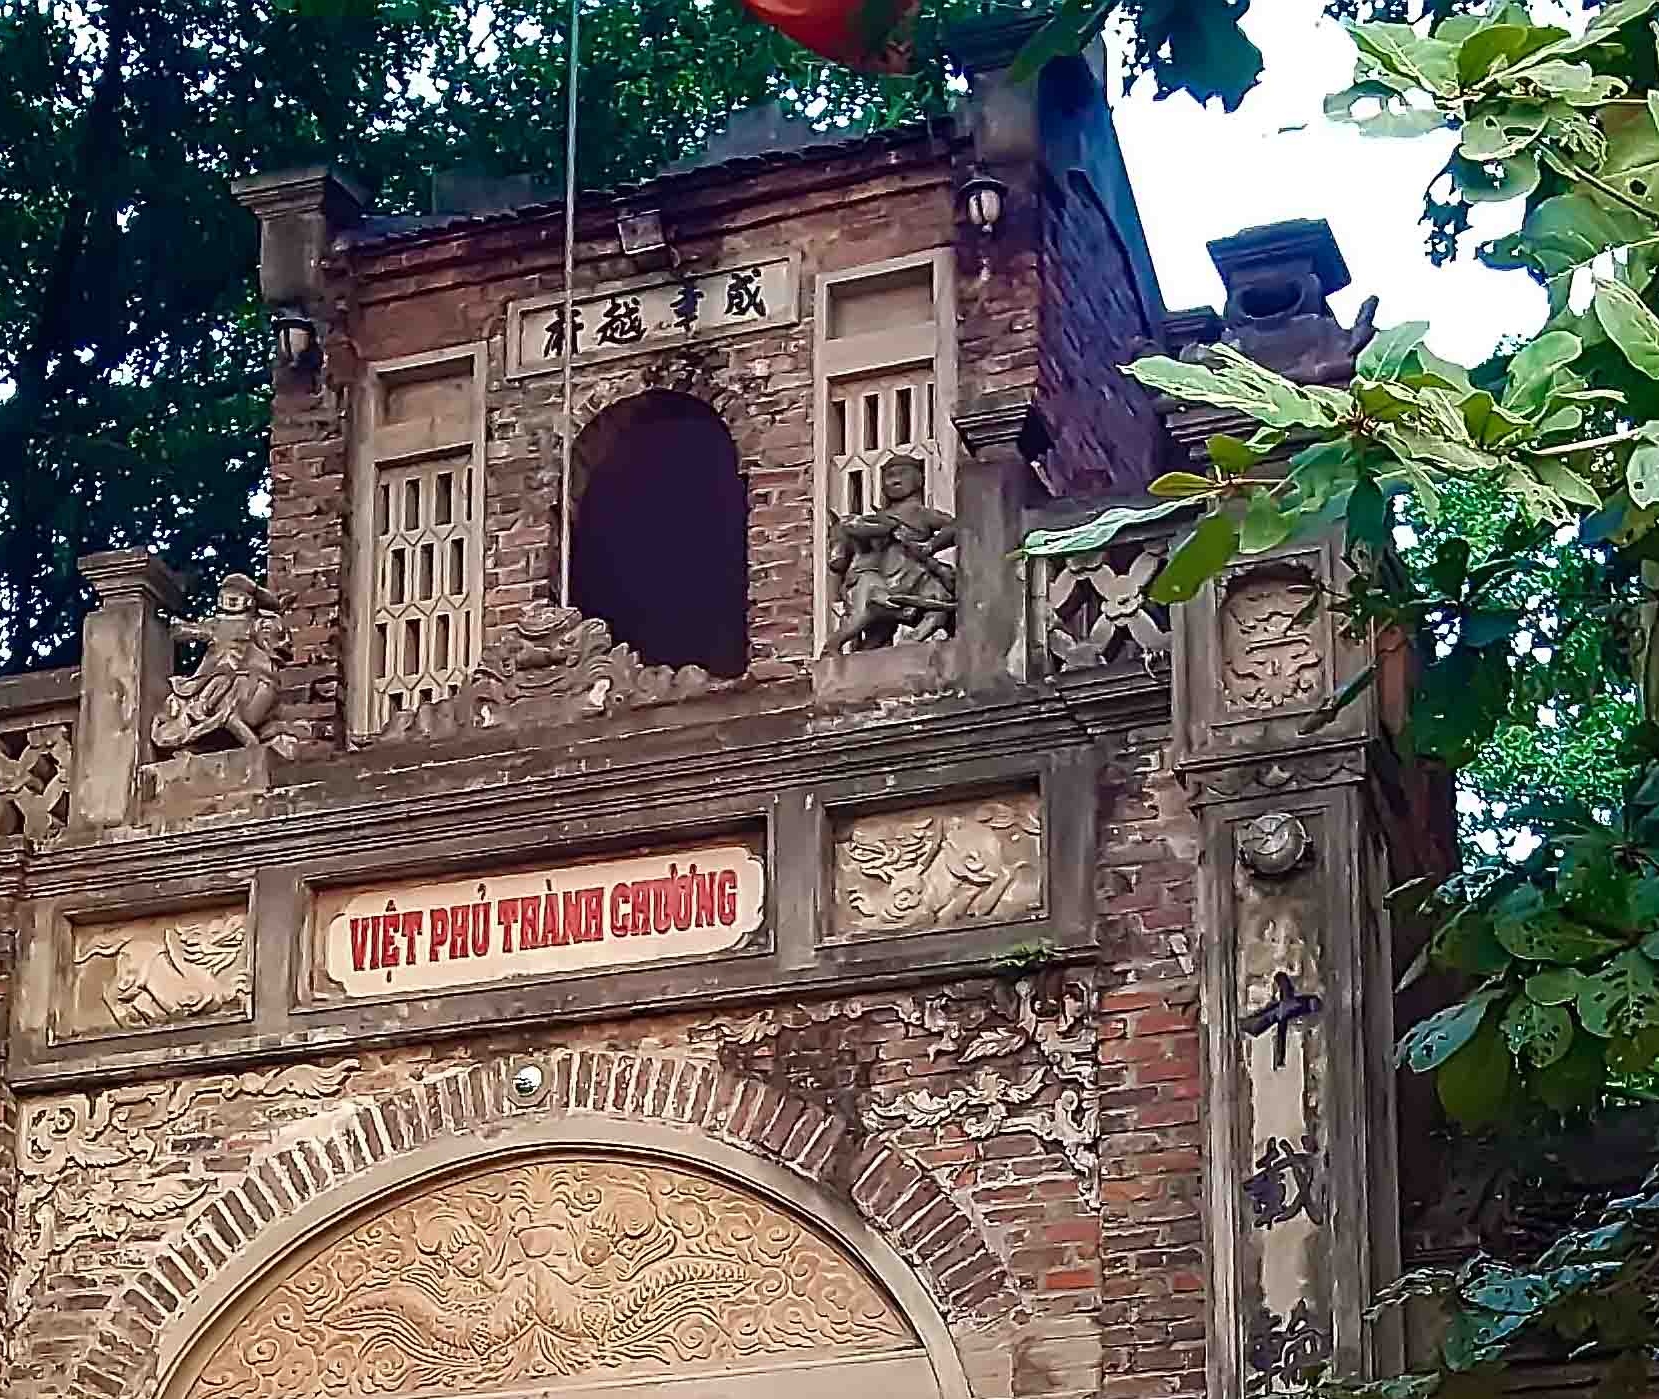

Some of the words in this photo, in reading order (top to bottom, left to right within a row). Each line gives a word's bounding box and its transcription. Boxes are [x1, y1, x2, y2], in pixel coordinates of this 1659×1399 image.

[349, 900, 423, 983] VIỆT
[429, 883, 492, 962] PHỦ
[498, 879, 605, 953] THÀNH
[610, 863, 738, 938] CHƯƠNG
